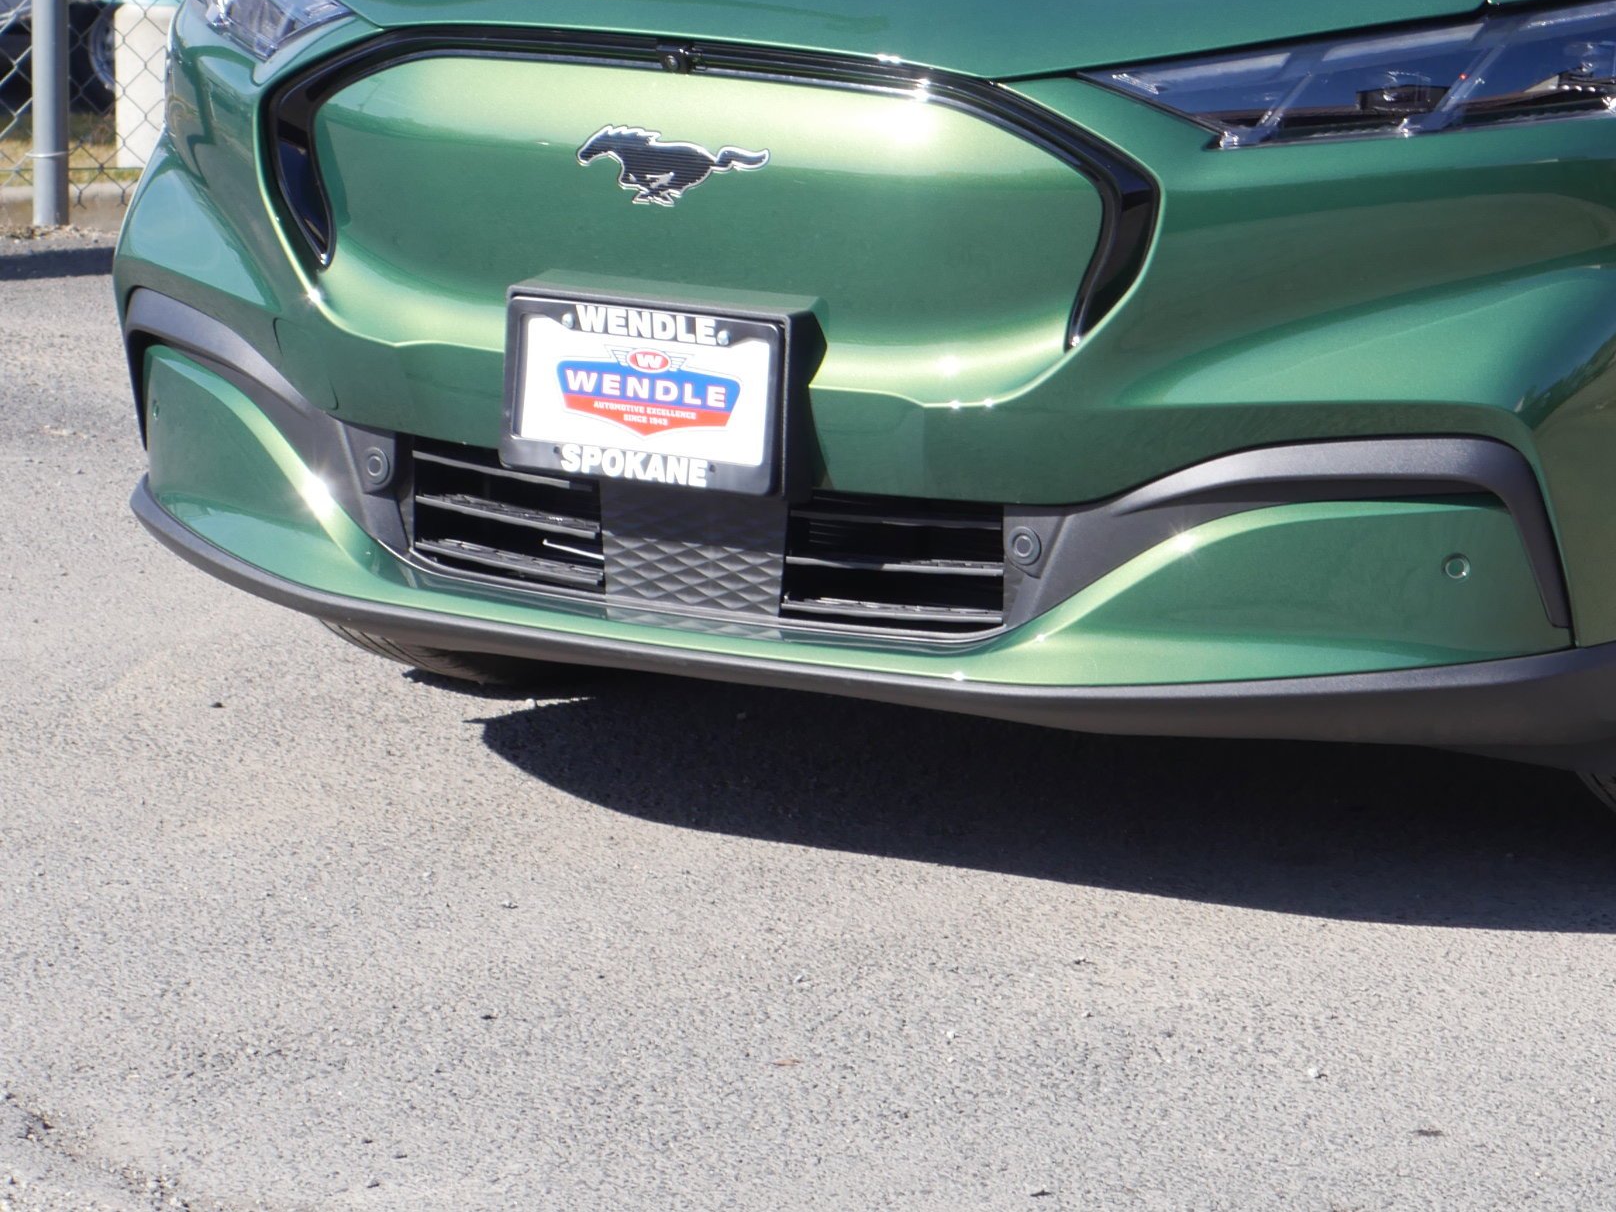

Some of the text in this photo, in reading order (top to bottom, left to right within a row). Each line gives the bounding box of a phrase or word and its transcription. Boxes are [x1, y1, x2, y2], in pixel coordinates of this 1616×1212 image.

[575, 304, 717, 346] WENDLE
[565, 369, 727, 408] WENDLE
[593, 400, 697, 420] AUTOMOTIVE EXCELLENCE
[623, 414, 648, 424] SINCE
[560, 443, 708, 487] SPOKANE
